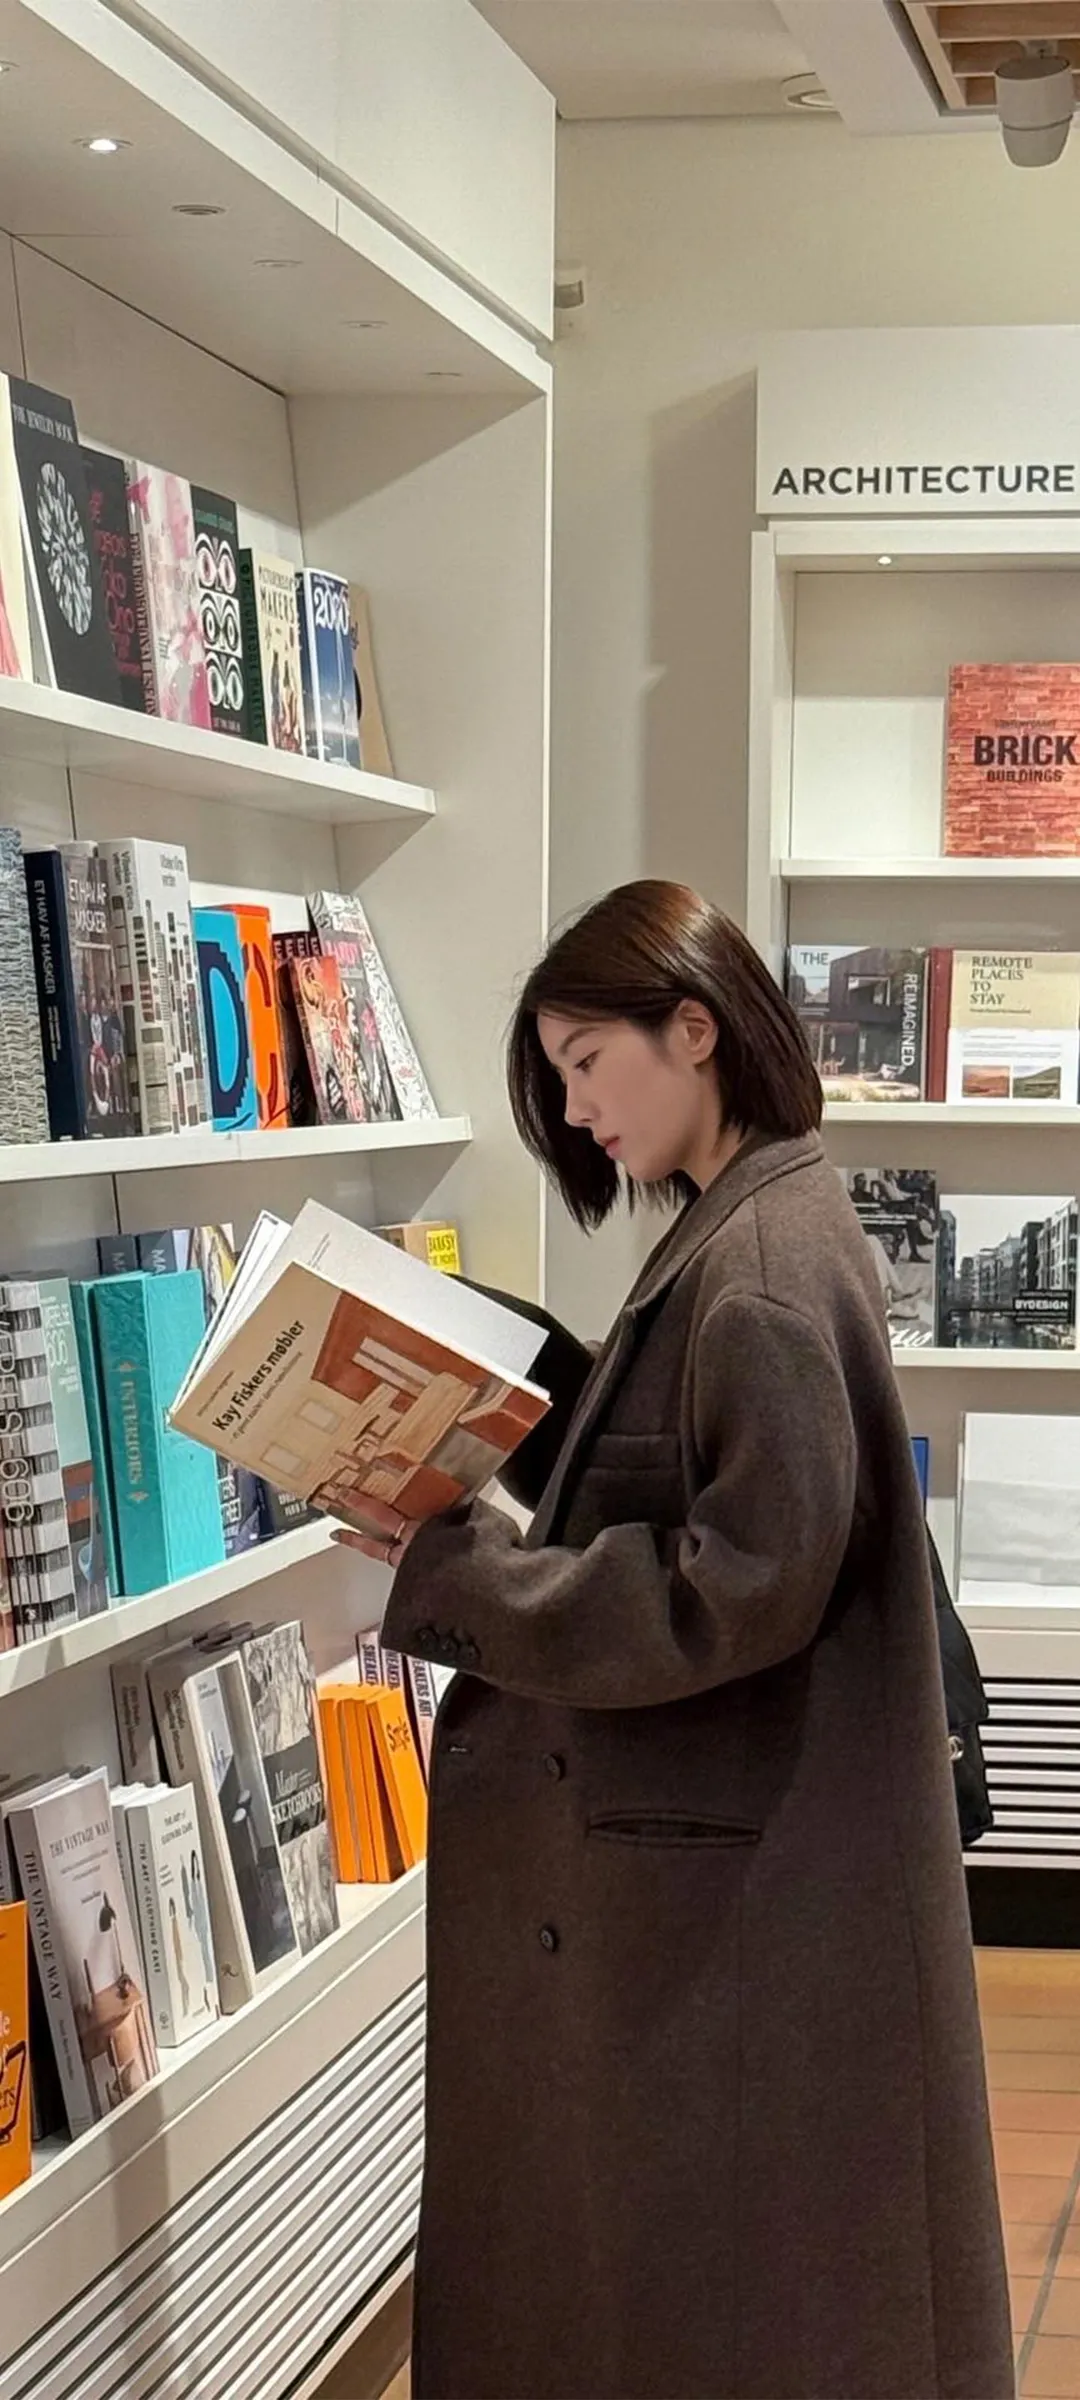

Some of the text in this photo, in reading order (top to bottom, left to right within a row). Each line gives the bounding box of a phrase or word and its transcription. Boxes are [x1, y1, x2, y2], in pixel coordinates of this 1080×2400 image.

[772, 464, 1075, 496] ARCHITECTURE
[260, 586, 295, 623] MAKERS
[974, 735, 1079, 766] BRICK
[987, 769, 1063, 783] BUILDINGS
[34, 880, 43, 896] ET
[36, 898, 47, 923] HAV
[75, 909, 108, 934] MASKER
[40, 925, 49, 941] AF
[42, 943, 56, 994] MASKER
[800, 951, 829, 965] THE
[971, 956, 1033, 969] REMOTE
[970, 980, 991, 992] TO
[971, 968, 1024, 980] PLACES
[970, 993, 1005, 1005] STAY
[900, 973, 918, 1067] REIMAGINED
[212, 1403, 242, 1431] Kay
[231, 1363, 272, 1406] Fiskers
[266, 1320, 304, 1366] møbler
[119, 1381, 146, 1486] INTERIORS
[1, 1457, 34, 1523] 606
[419, 1699, 433, 1718] ART
[49, 1839, 64, 1858] THE
[64, 1826, 95, 1850] VINTAGE
[138, 1844, 147, 1860] THE
[141, 1864, 150, 1882] ART
[23, 1851, 62, 2001] THE VINTAGE WAY
[145, 1896, 158, 1945] CLOTHING
[152, 1949, 162, 1974] CARE
